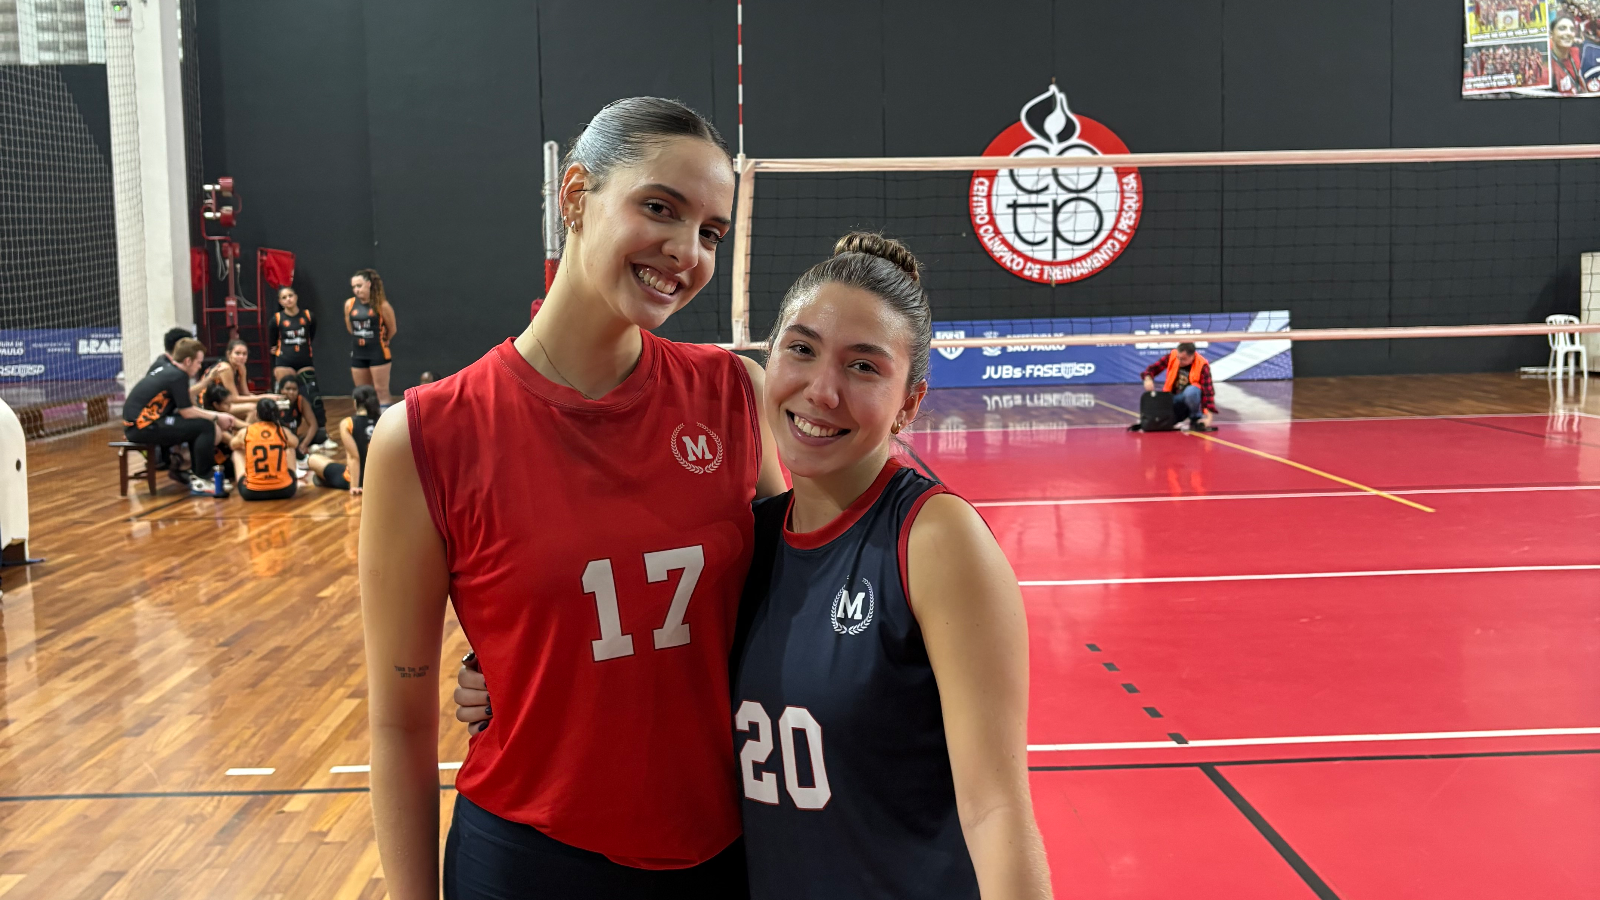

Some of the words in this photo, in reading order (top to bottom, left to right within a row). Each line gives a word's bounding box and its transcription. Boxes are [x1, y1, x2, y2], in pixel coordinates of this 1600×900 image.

[972, 176, 990, 225] CENTRO
[1118, 173, 1139, 234] PESQUISA
[979, 225, 1025, 272] OLÍMPICO
[1006, 195, 1104, 261] tp
[1114, 231, 1127, 242] E
[1022, 263, 1042, 279] DE
[1042, 240, 1121, 280] TREINAMENTO
[252, 444, 283, 473] 27
[681, 435, 714, 462] M
[580, 544, 705, 663] 17
[836, 590, 866, 620] M
[735, 700, 832, 811] 20
